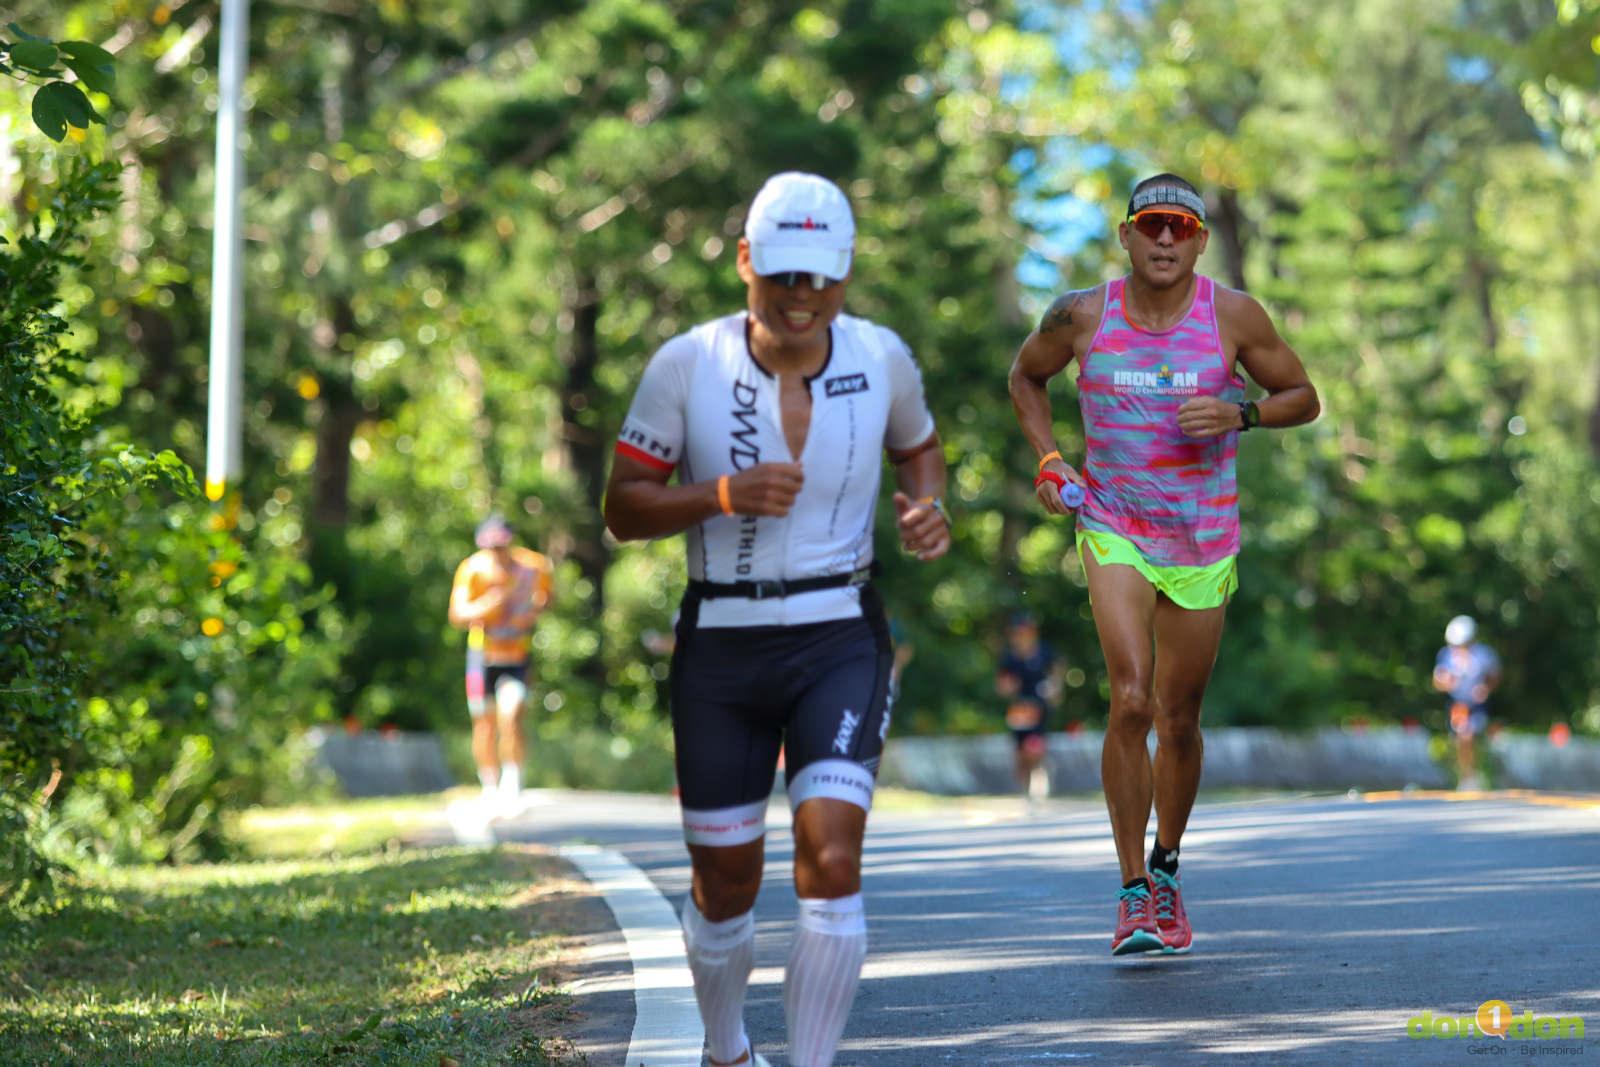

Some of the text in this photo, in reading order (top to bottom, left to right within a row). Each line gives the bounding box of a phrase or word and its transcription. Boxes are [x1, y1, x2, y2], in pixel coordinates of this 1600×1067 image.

[1113, 386, 1198, 396] WORLD CHAMPIONSHIP
[736, 515, 757, 576] ATHLO
